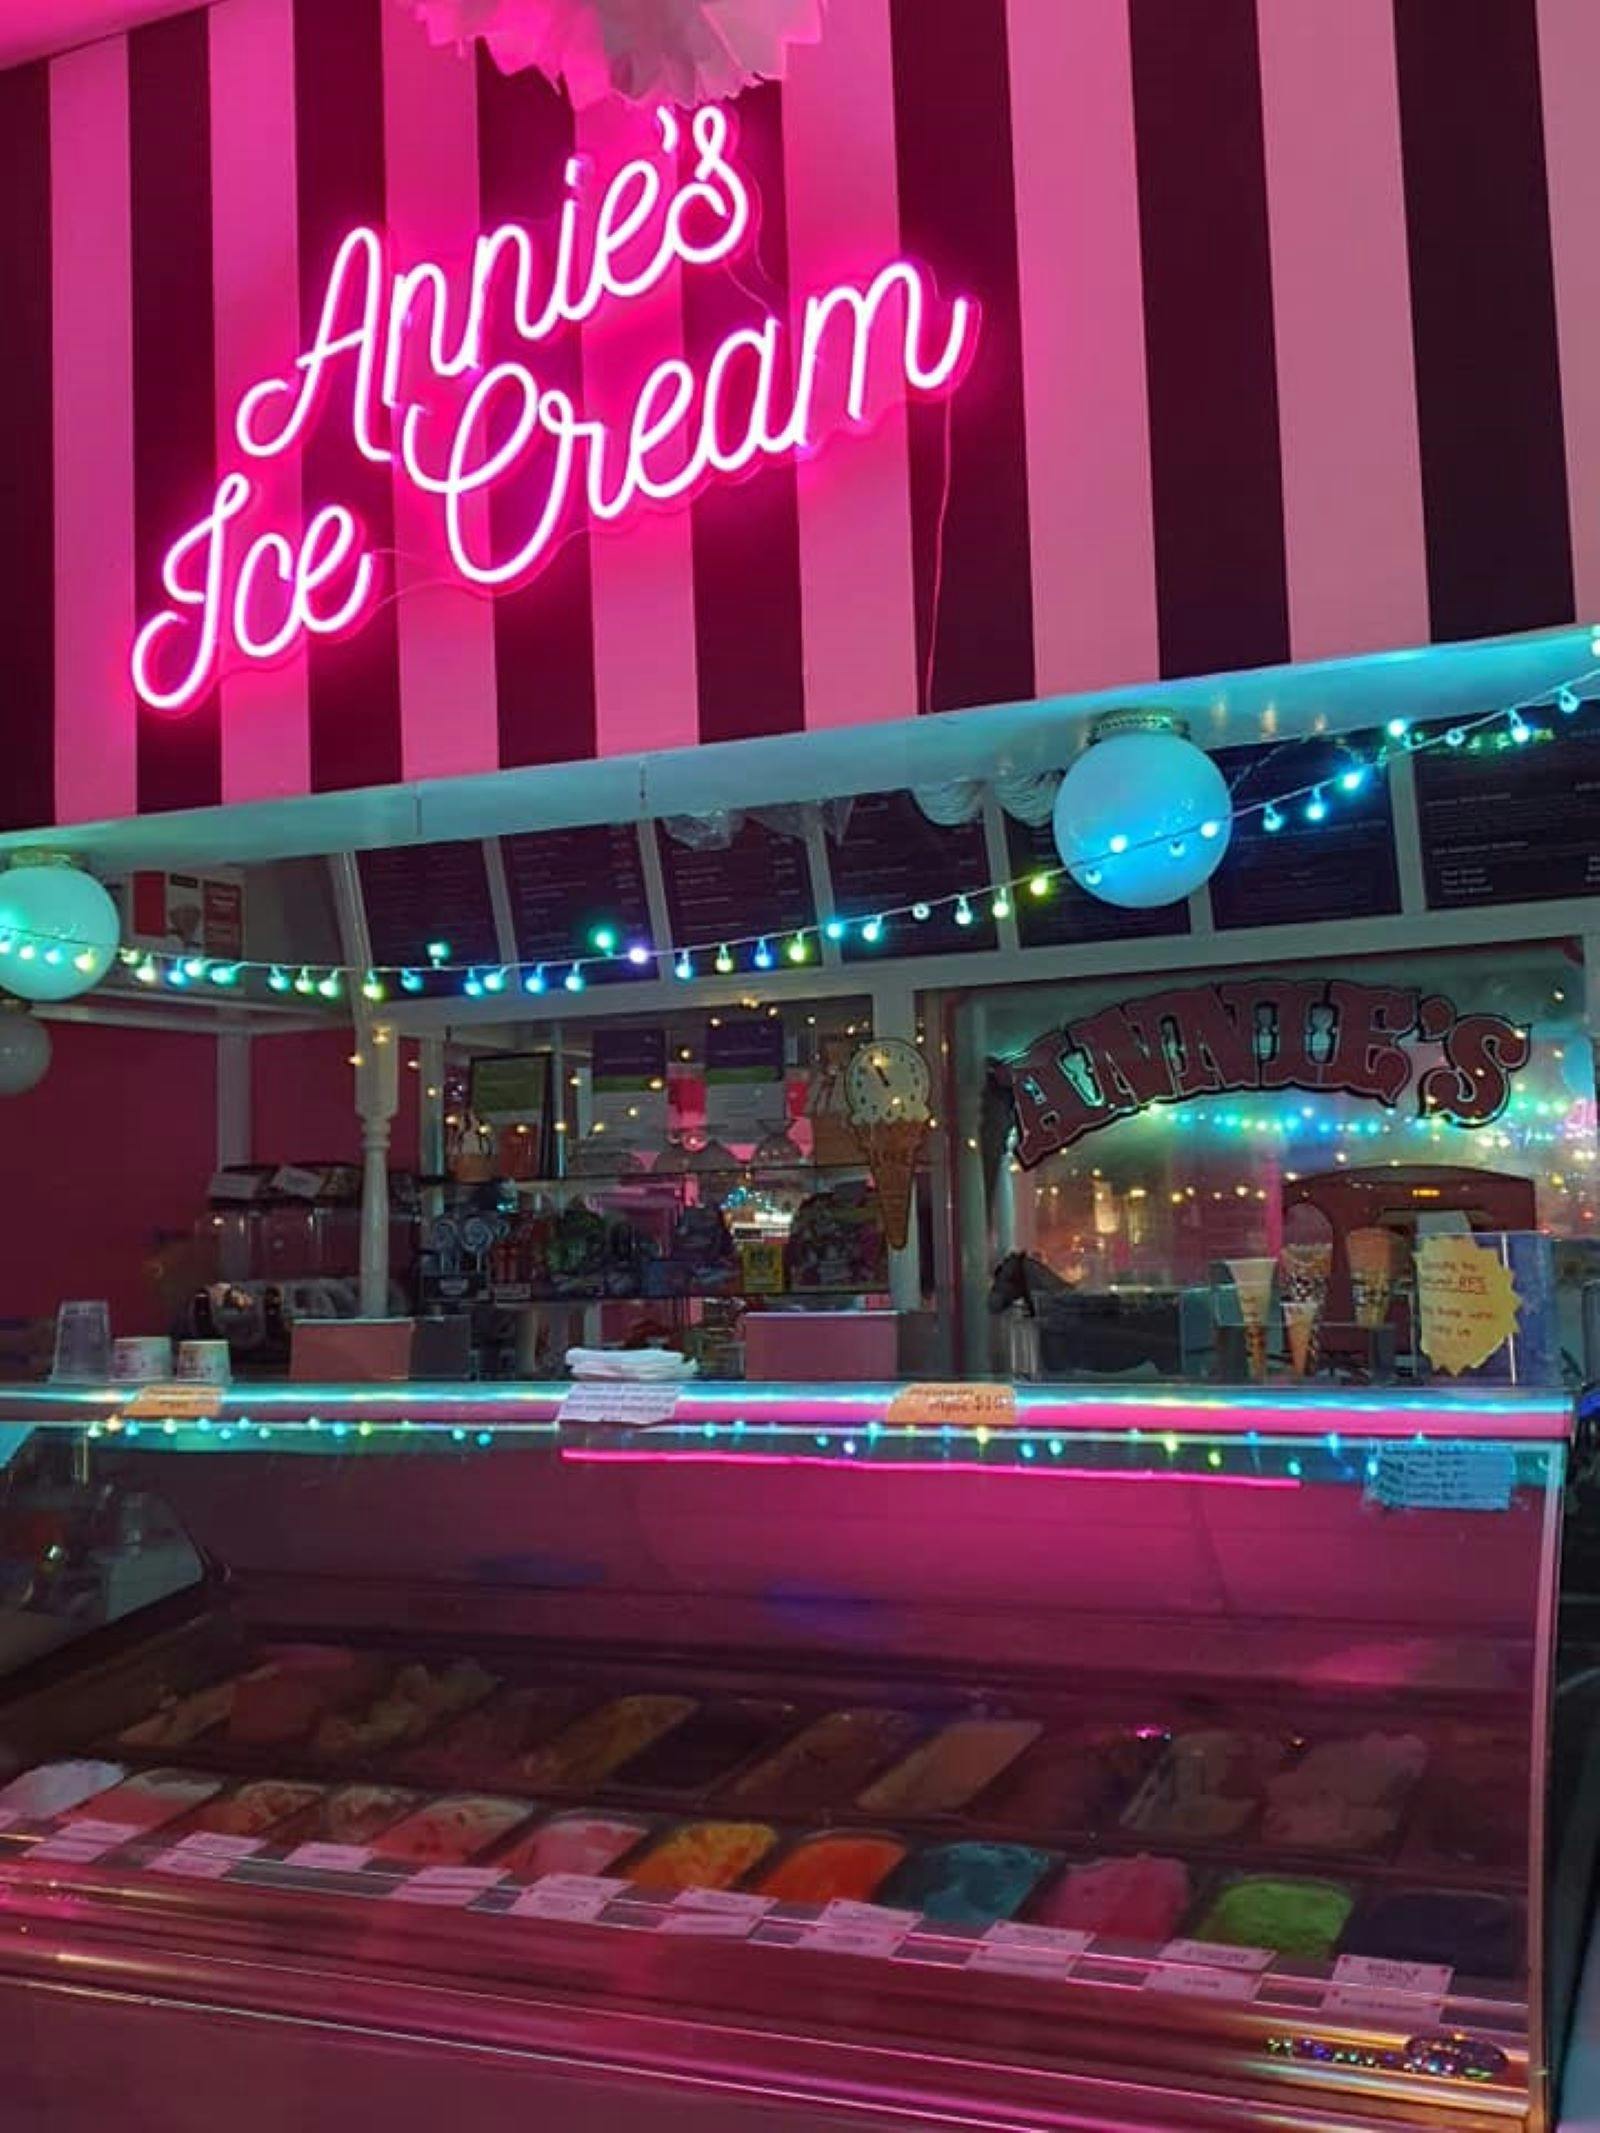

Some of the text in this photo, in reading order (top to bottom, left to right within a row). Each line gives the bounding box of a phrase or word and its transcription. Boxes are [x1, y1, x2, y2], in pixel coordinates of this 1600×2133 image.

[236, 103, 749, 462] Annie's
[132, 261, 972, 710] Ice Cream
[1009, 979, 1533, 1170] ANNIE'S
